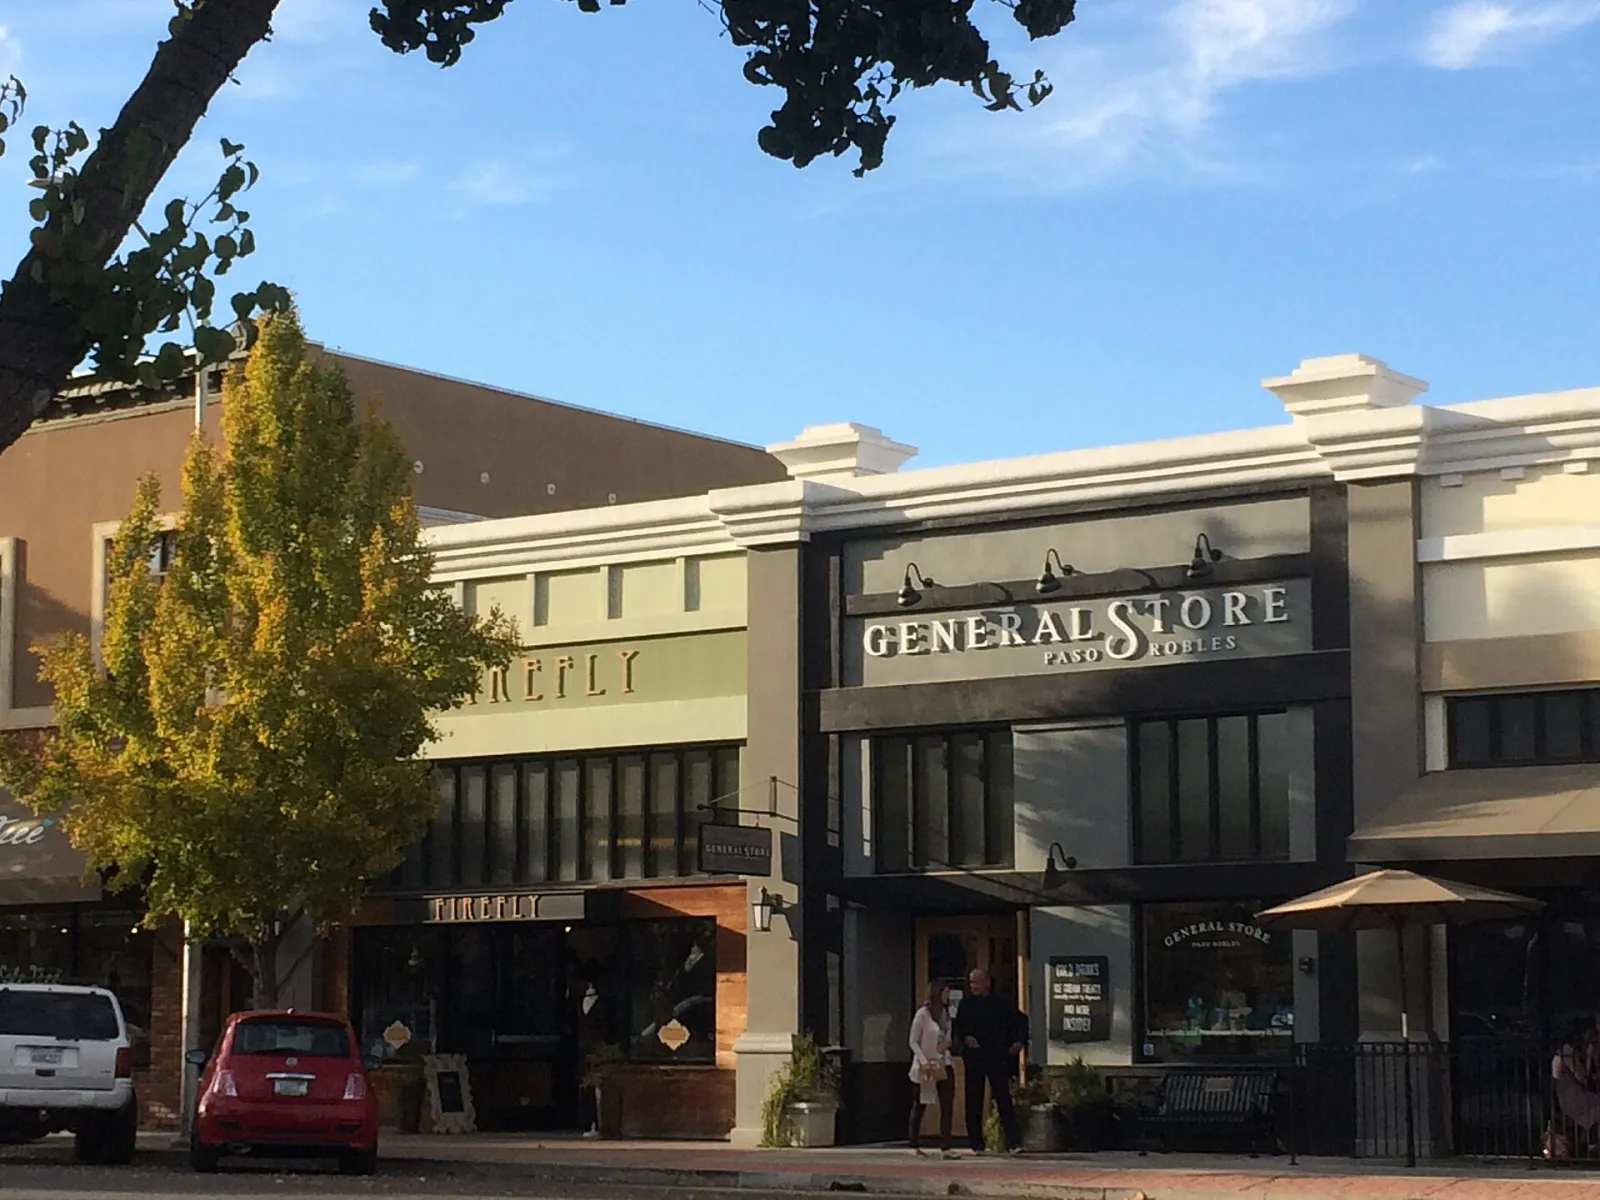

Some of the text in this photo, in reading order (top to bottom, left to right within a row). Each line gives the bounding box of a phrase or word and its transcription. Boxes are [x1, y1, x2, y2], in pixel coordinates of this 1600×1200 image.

[863, 587, 1289, 660] GENERAL STORE
[1044, 635, 1237, 666] PASO ROBLES
[464, 650, 640, 704] REFLY
[434, 895, 540, 921] FIREFLY
[1164, 921, 1272, 947] GENERAL STORE
